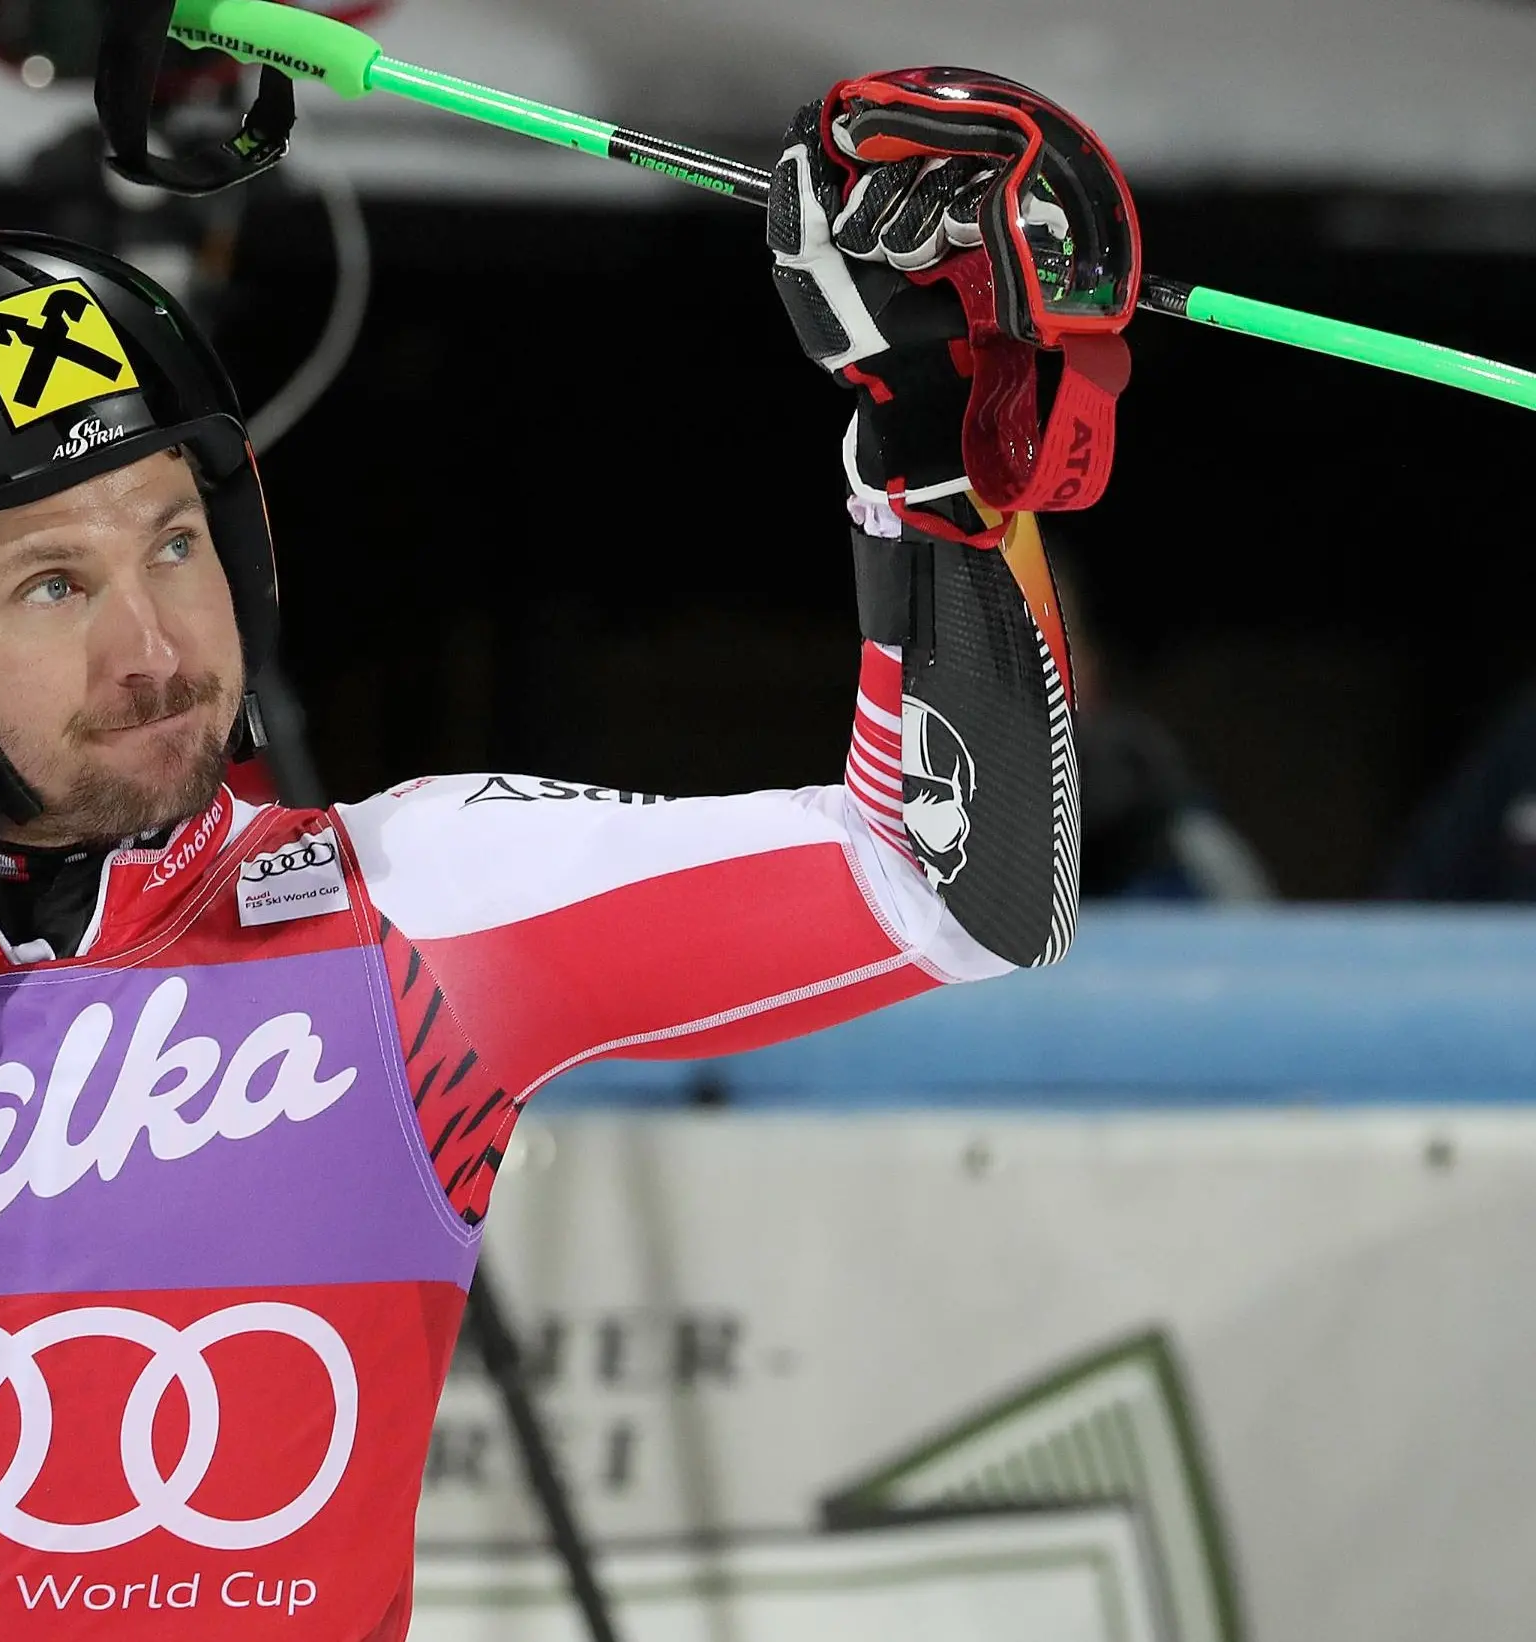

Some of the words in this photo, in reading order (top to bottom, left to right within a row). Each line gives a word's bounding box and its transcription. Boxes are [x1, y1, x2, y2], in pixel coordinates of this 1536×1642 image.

[245, 890, 271, 902] Audi
[245, 900, 263, 909] FIS
[283, 890, 317, 902] World
[319, 885, 340, 896] Cup
[15, 1571, 202, 1612] World
[220, 1570, 318, 1616] Cup
